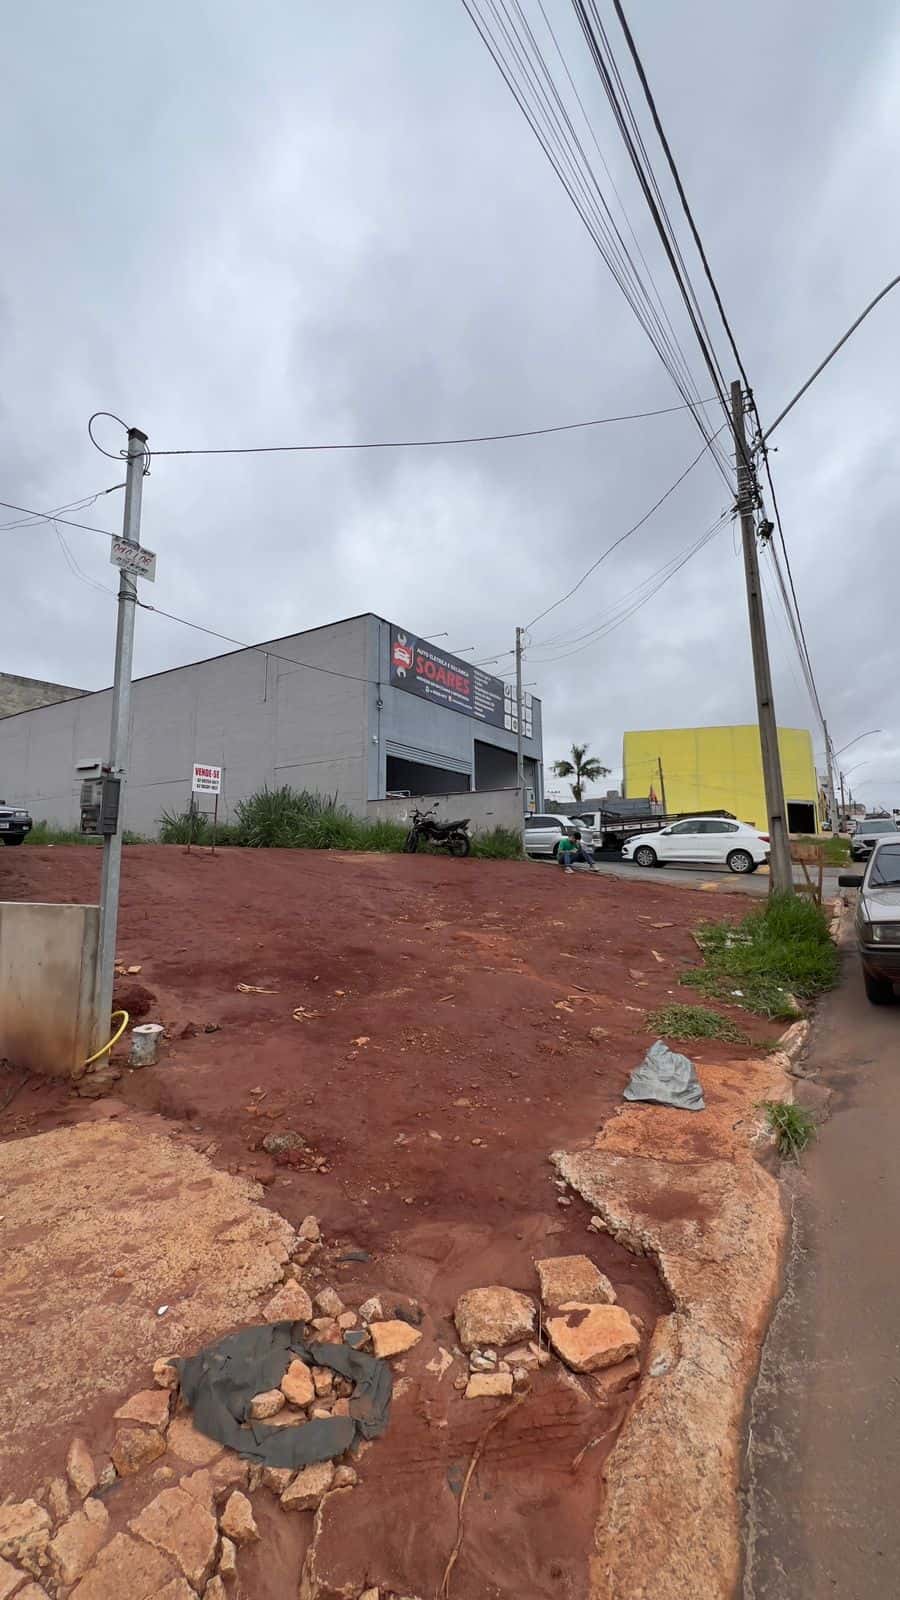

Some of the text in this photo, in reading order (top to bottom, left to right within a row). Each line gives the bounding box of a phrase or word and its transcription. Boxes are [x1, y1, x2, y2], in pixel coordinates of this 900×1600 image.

[416, 648, 428, 658] AUTO
[416, 656, 470, 696] SOARES
[195, 768, 220, 779] VENDE-SE
